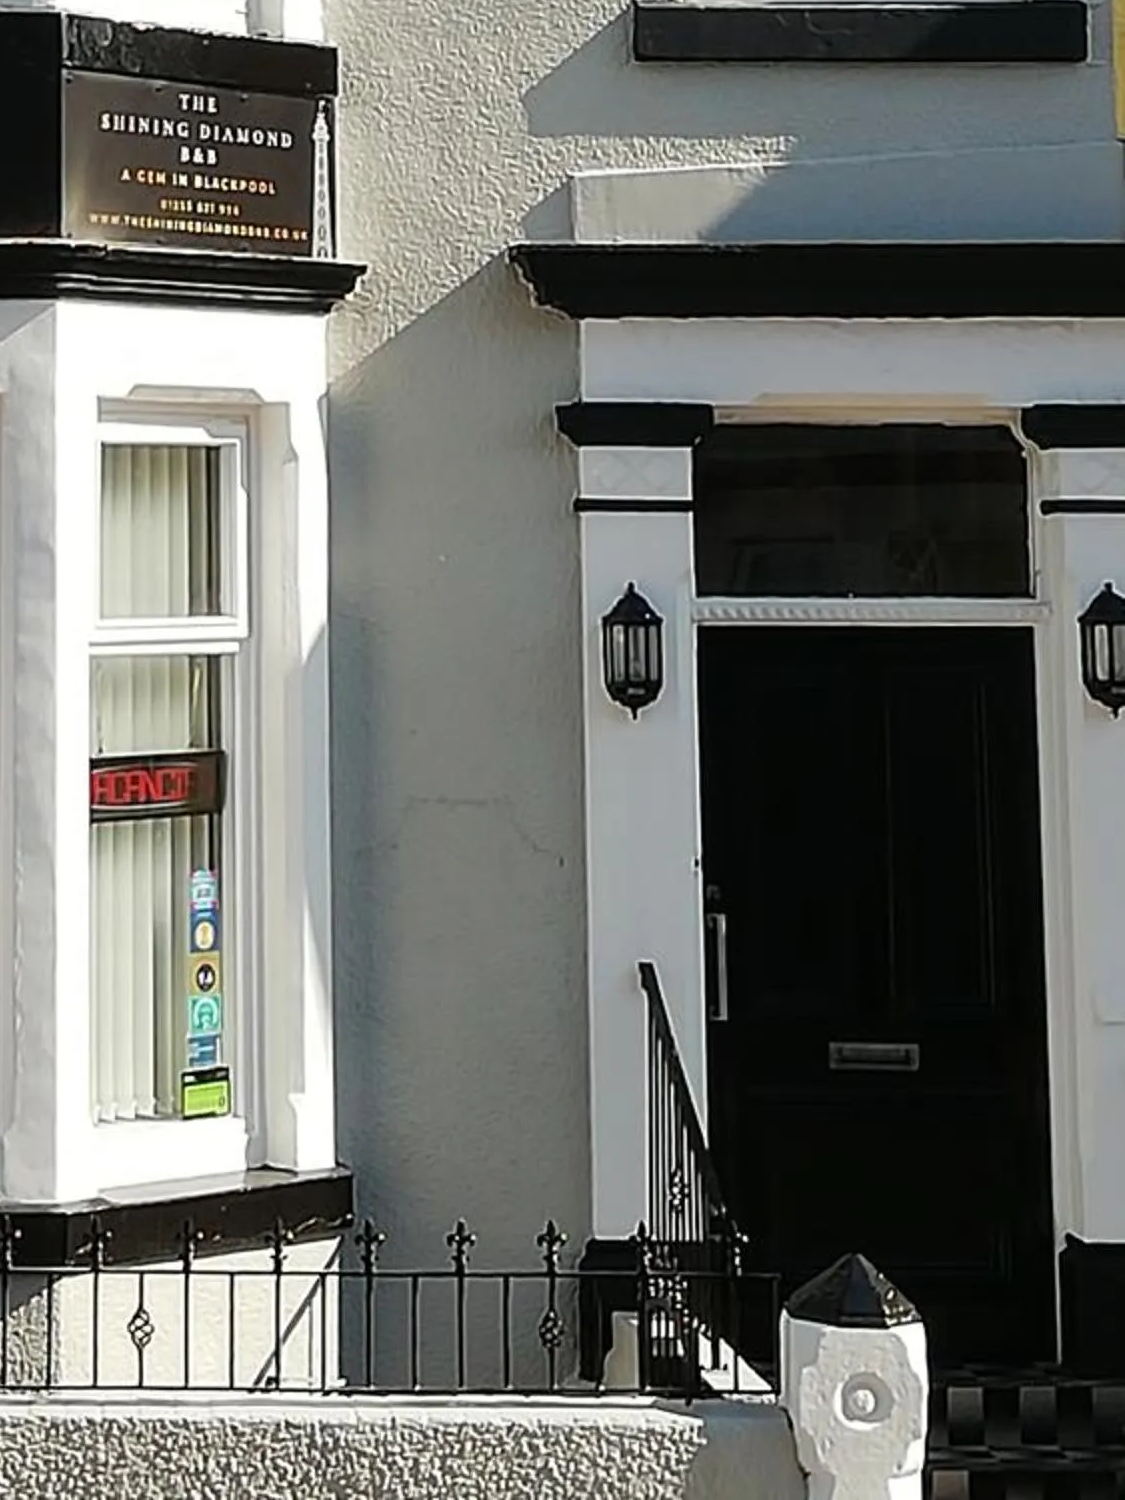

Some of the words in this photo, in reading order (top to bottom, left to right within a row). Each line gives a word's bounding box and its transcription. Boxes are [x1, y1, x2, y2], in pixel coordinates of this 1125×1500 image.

[178, 93, 219, 113] THE
[101, 113, 190, 138] SHINING
[199, 124, 293, 148] DIAMOND
[180, 146, 218, 165] B&B
[121, 168, 131, 182] A
[172, 173, 188, 188] IN
[193, 175, 276, 195] BLACKPOOL
